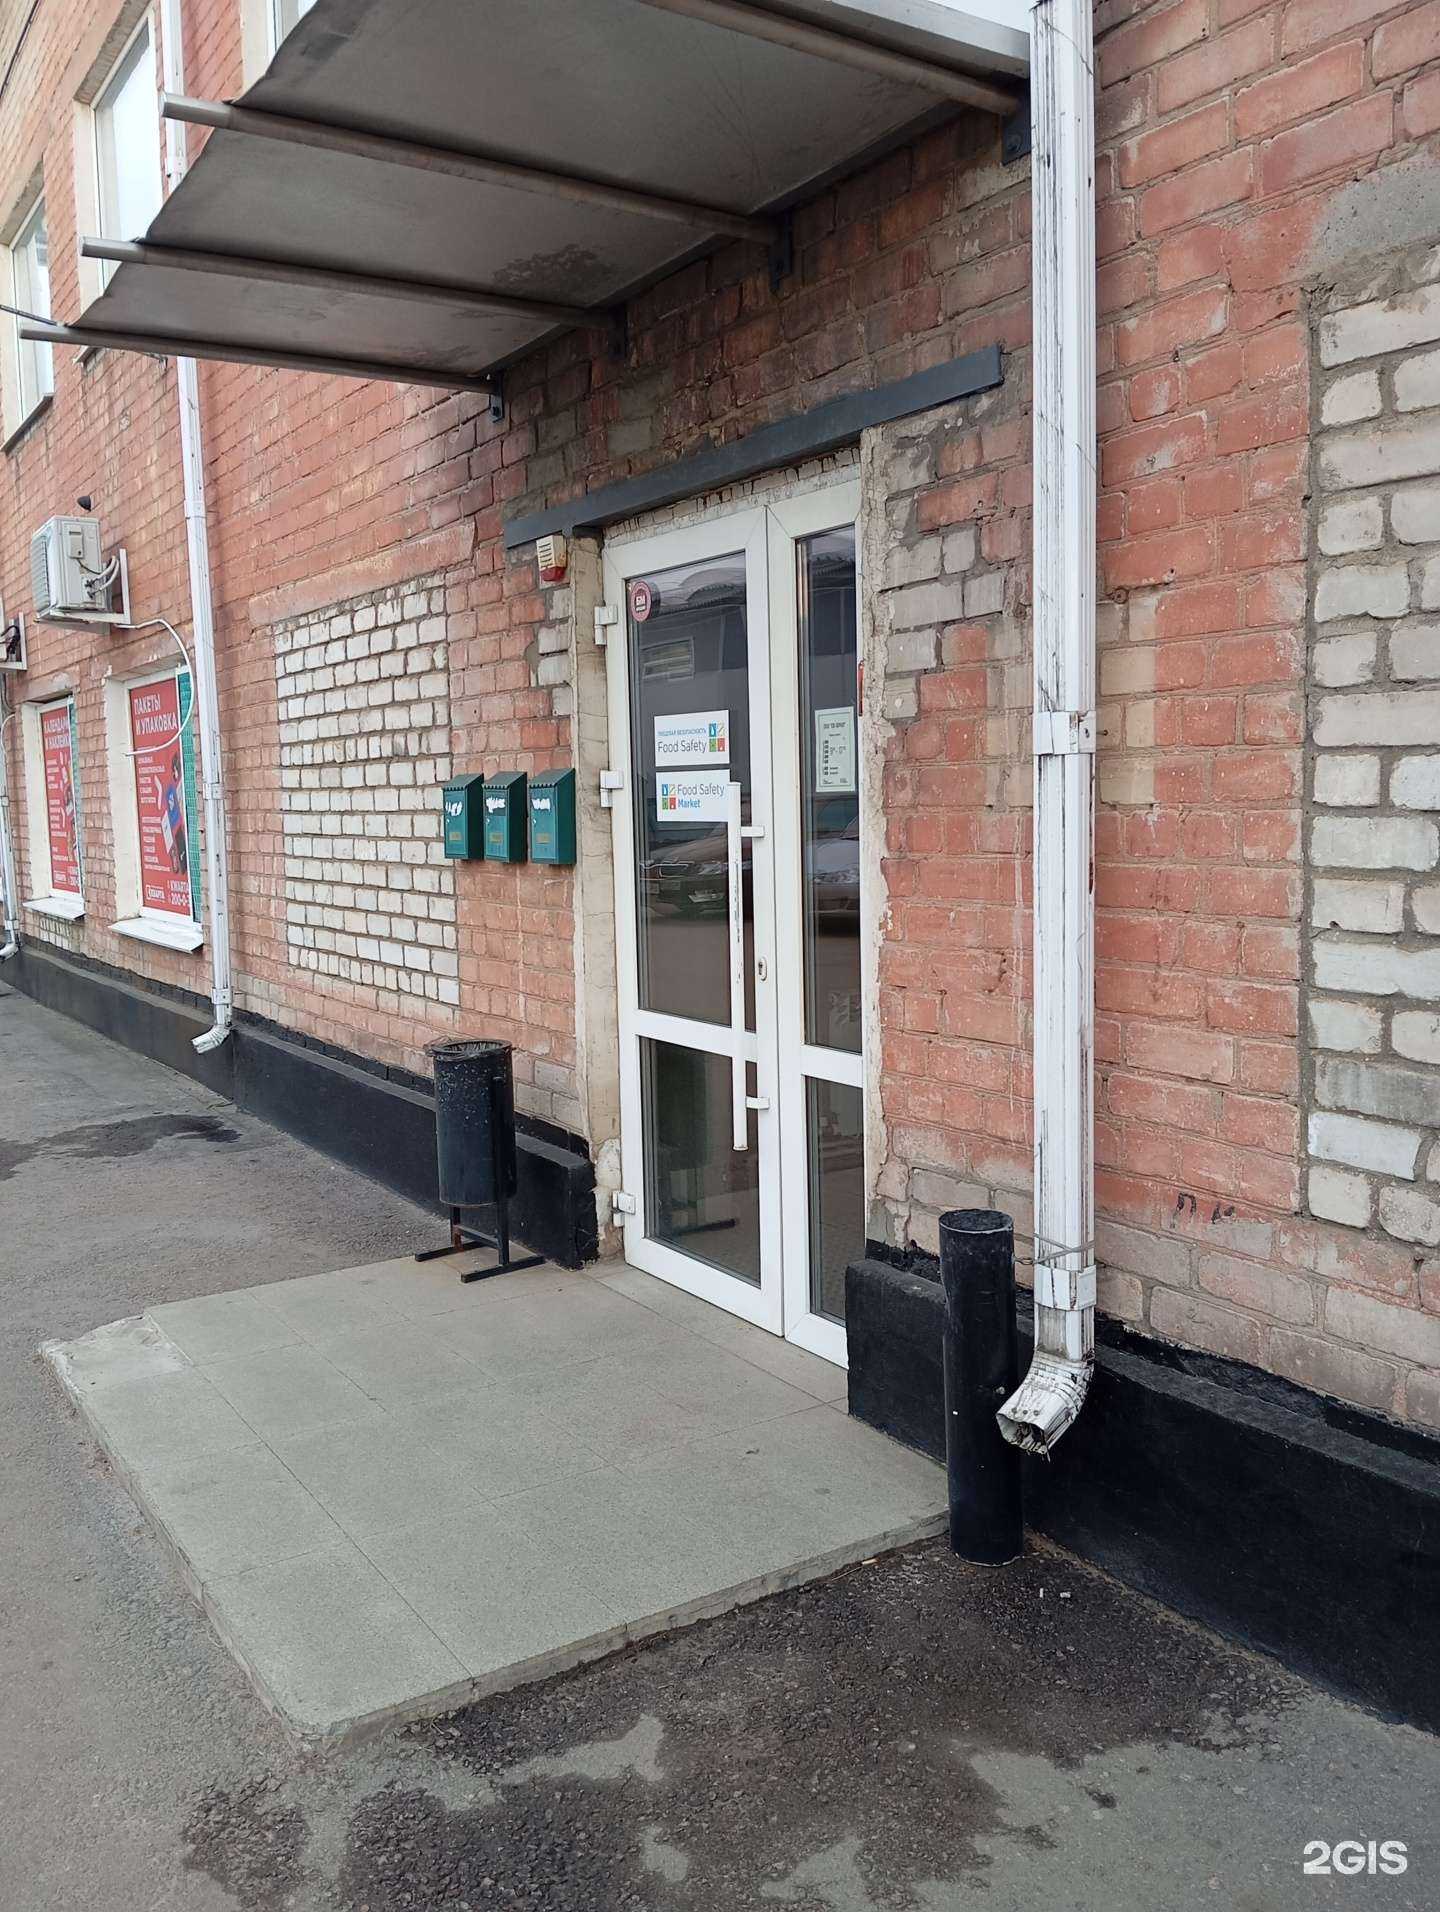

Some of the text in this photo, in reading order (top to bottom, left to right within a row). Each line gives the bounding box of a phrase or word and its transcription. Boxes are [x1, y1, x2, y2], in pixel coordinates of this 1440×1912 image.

[134, 693, 161, 714] ПАКЕТЫ
[135, 712, 178, 735] И УПАКОВКА
[657, 739, 707, 754] Food Safety
[677, 782, 725, 796] Food Safety
[678, 798, 701, 809] Market
